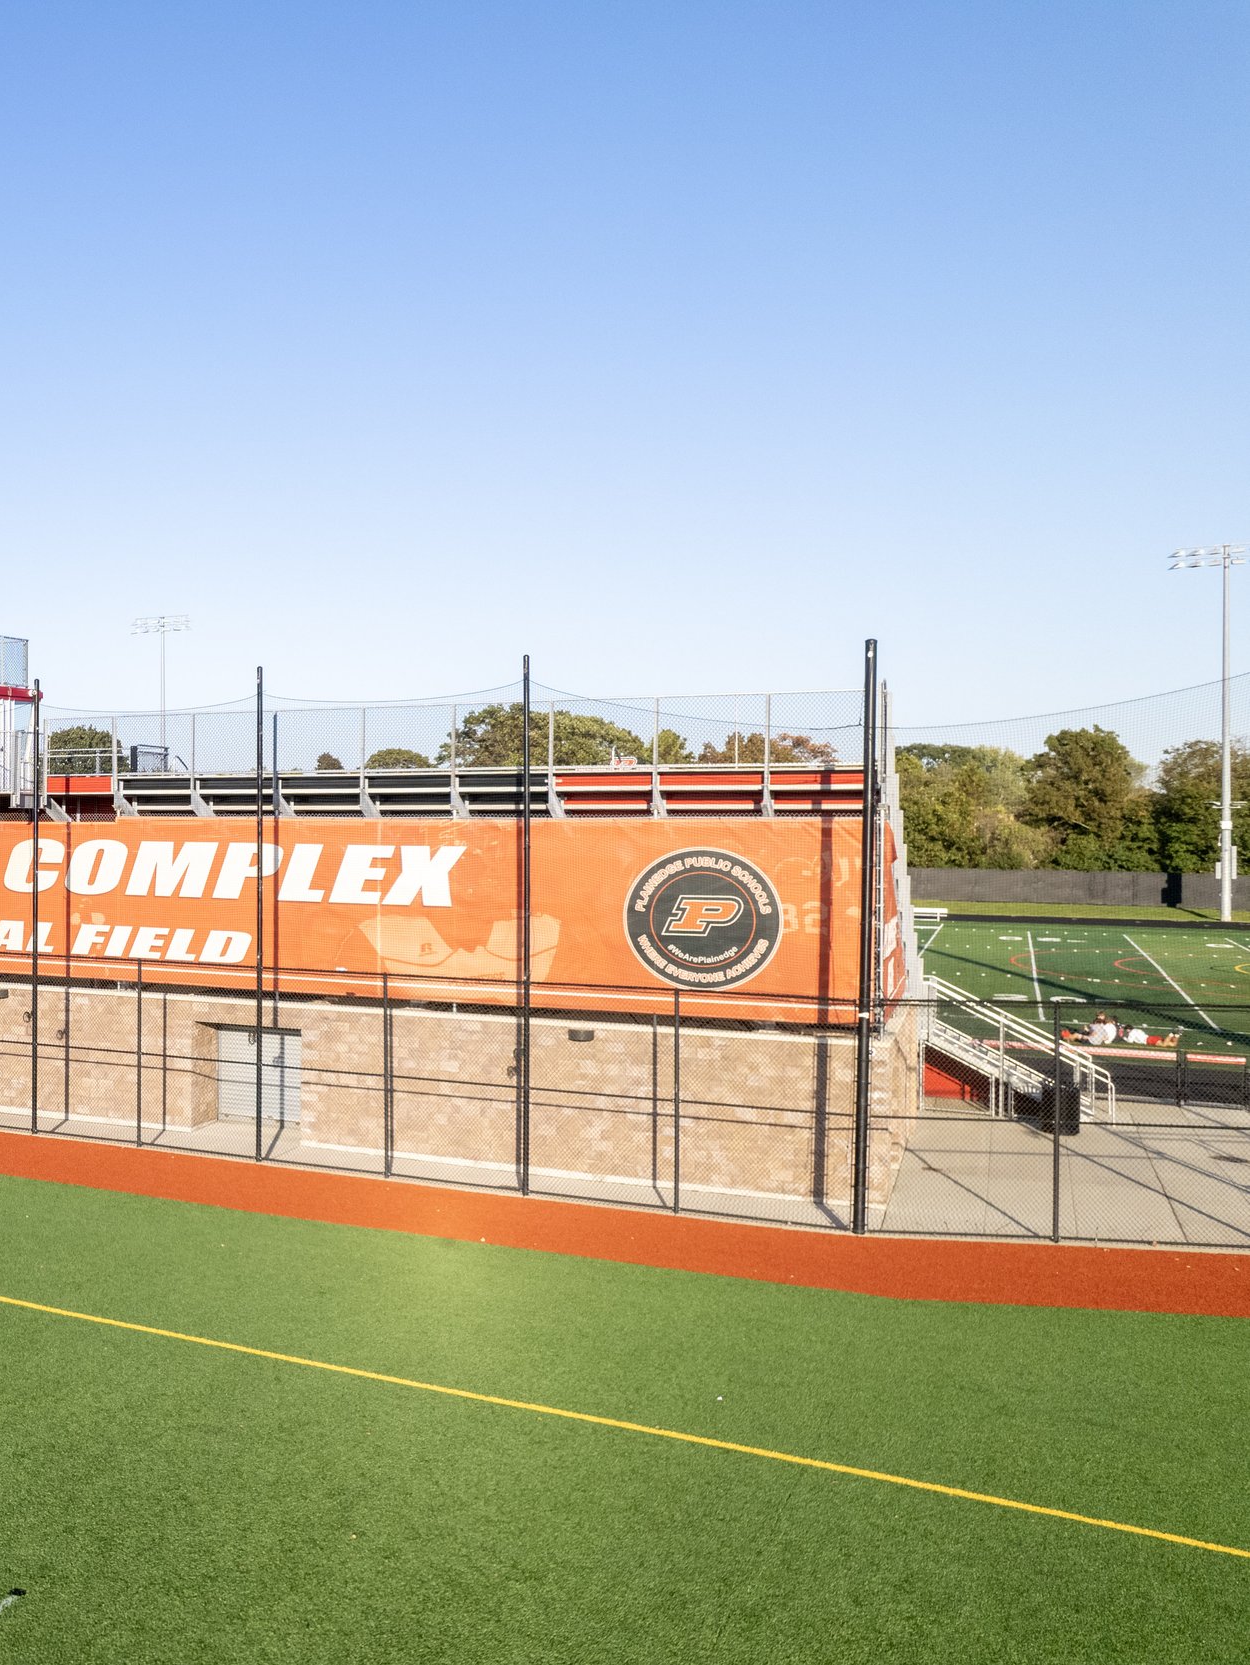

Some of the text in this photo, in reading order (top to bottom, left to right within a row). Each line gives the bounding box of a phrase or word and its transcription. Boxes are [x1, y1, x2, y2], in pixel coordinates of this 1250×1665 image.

[3, 838, 467, 907] COMPLEX
[635, 857, 772, 915] PLAINEDGE PUBLIC SCHOOLS
[661, 895, 744, 936] P
[71, 923, 252, 963] FIELD
[637, 934, 770, 983] WHERE EVERYONE ACHIEVES
[667, 944, 738, 964] #WeArePlainedge
